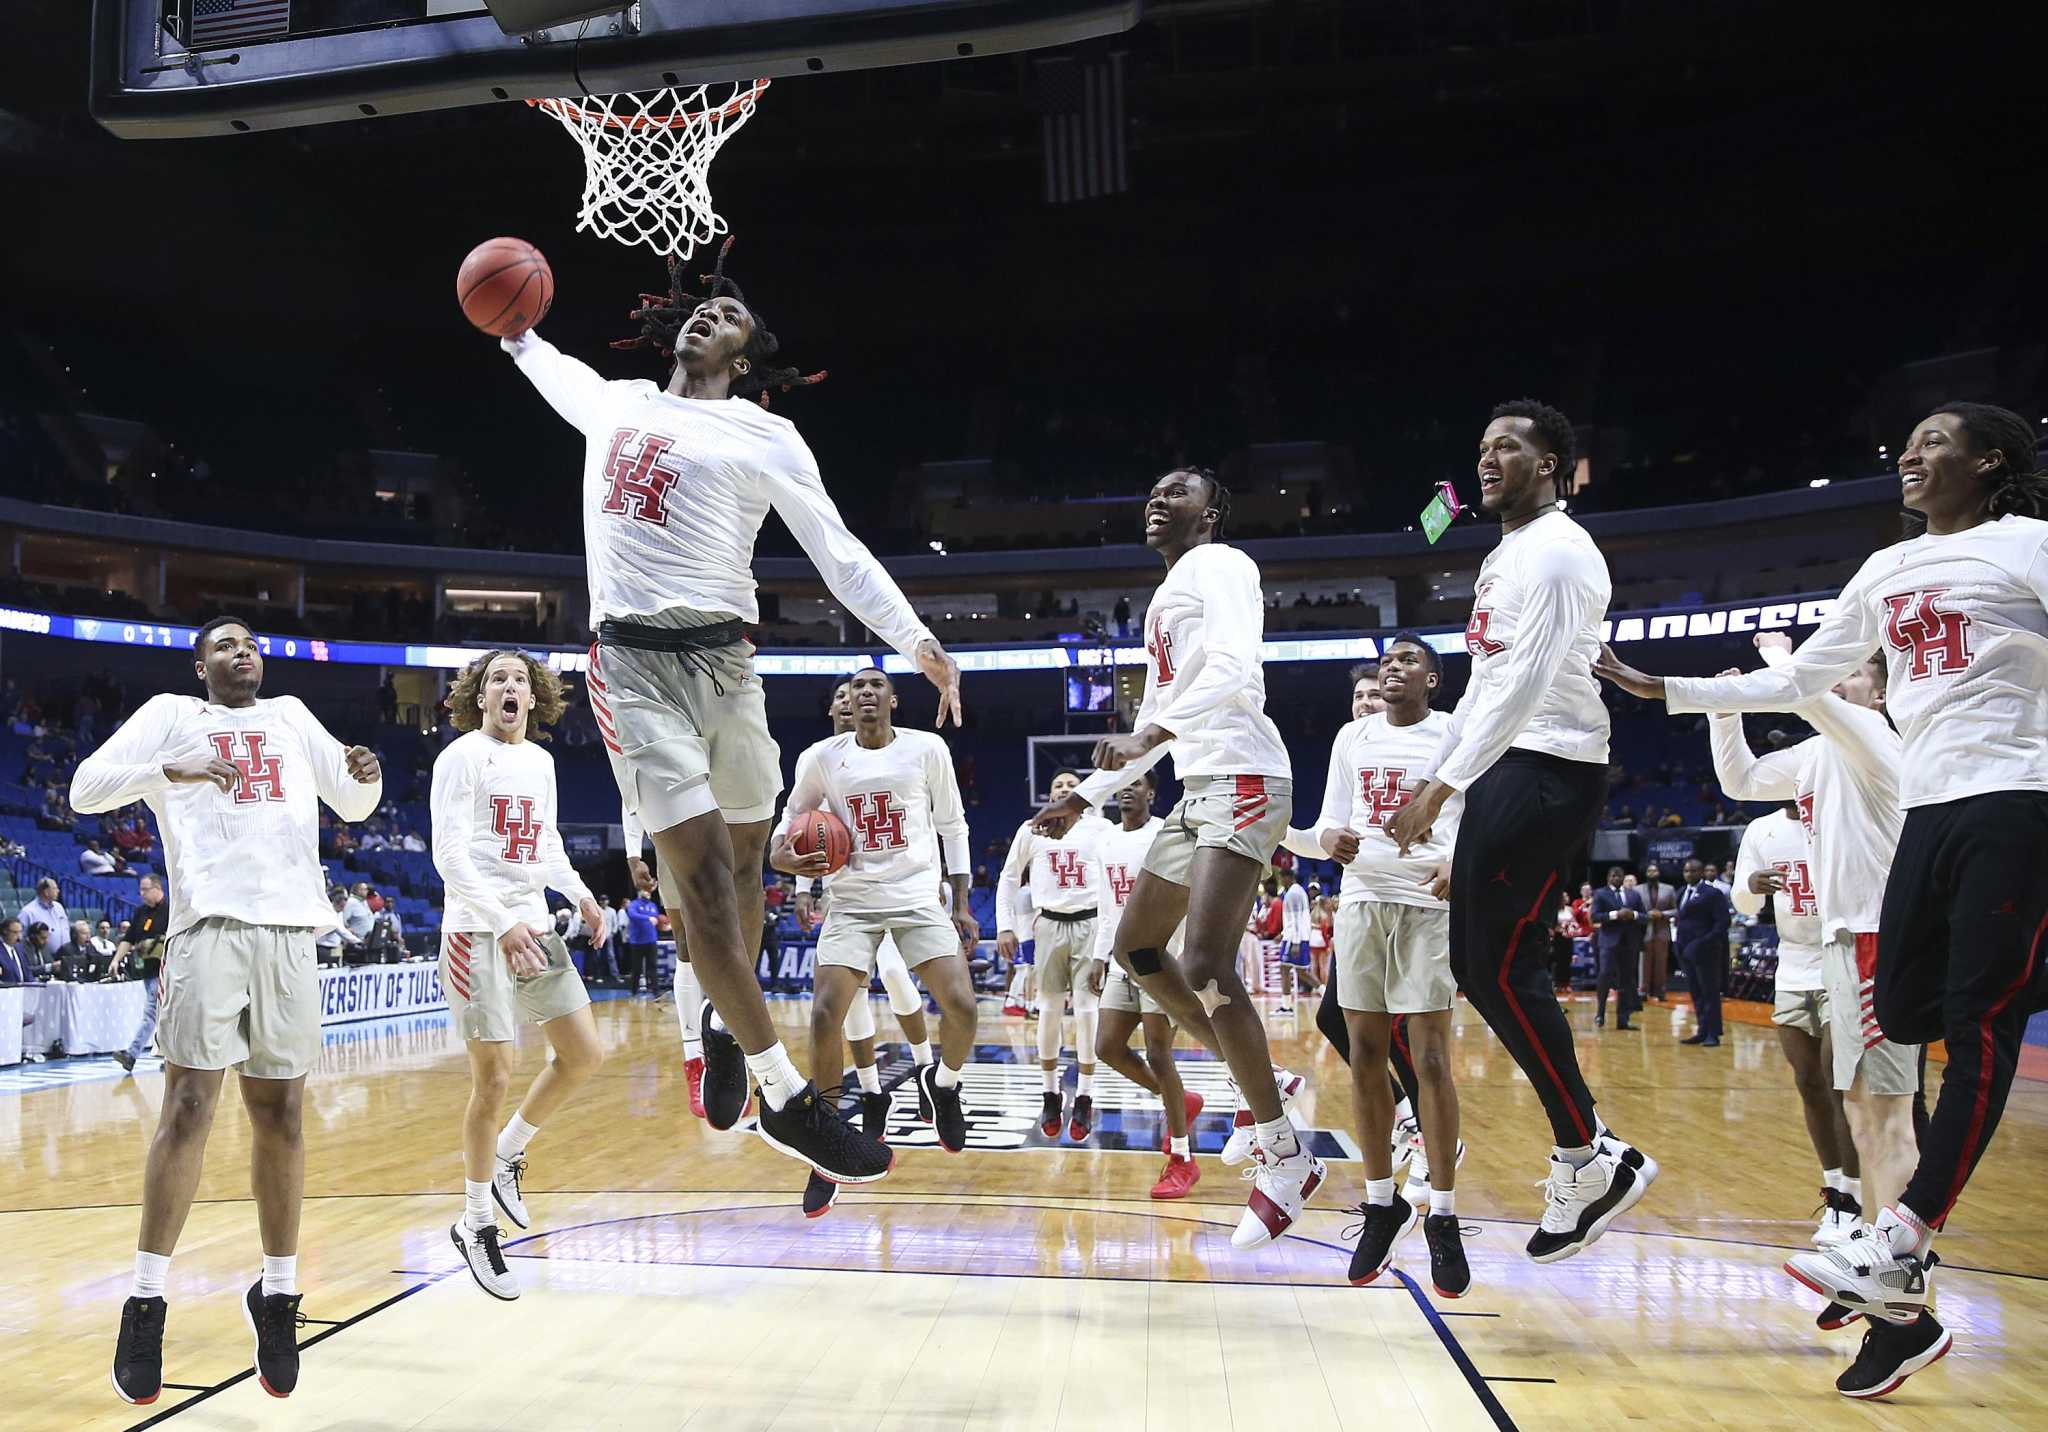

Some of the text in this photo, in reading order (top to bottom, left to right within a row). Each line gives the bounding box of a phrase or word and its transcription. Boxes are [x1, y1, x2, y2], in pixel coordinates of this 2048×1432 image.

[602, 427, 680, 527] UH
[1600, 599, 1838, 642] ADNESS
[1883, 588, 1974, 681] UH
[208, 731, 286, 804] UH
[489, 794, 543, 864] UH
[845, 790, 908, 852] UH
[1047, 849, 1087, 888] UH
[386, 972, 404, 1009] OF
